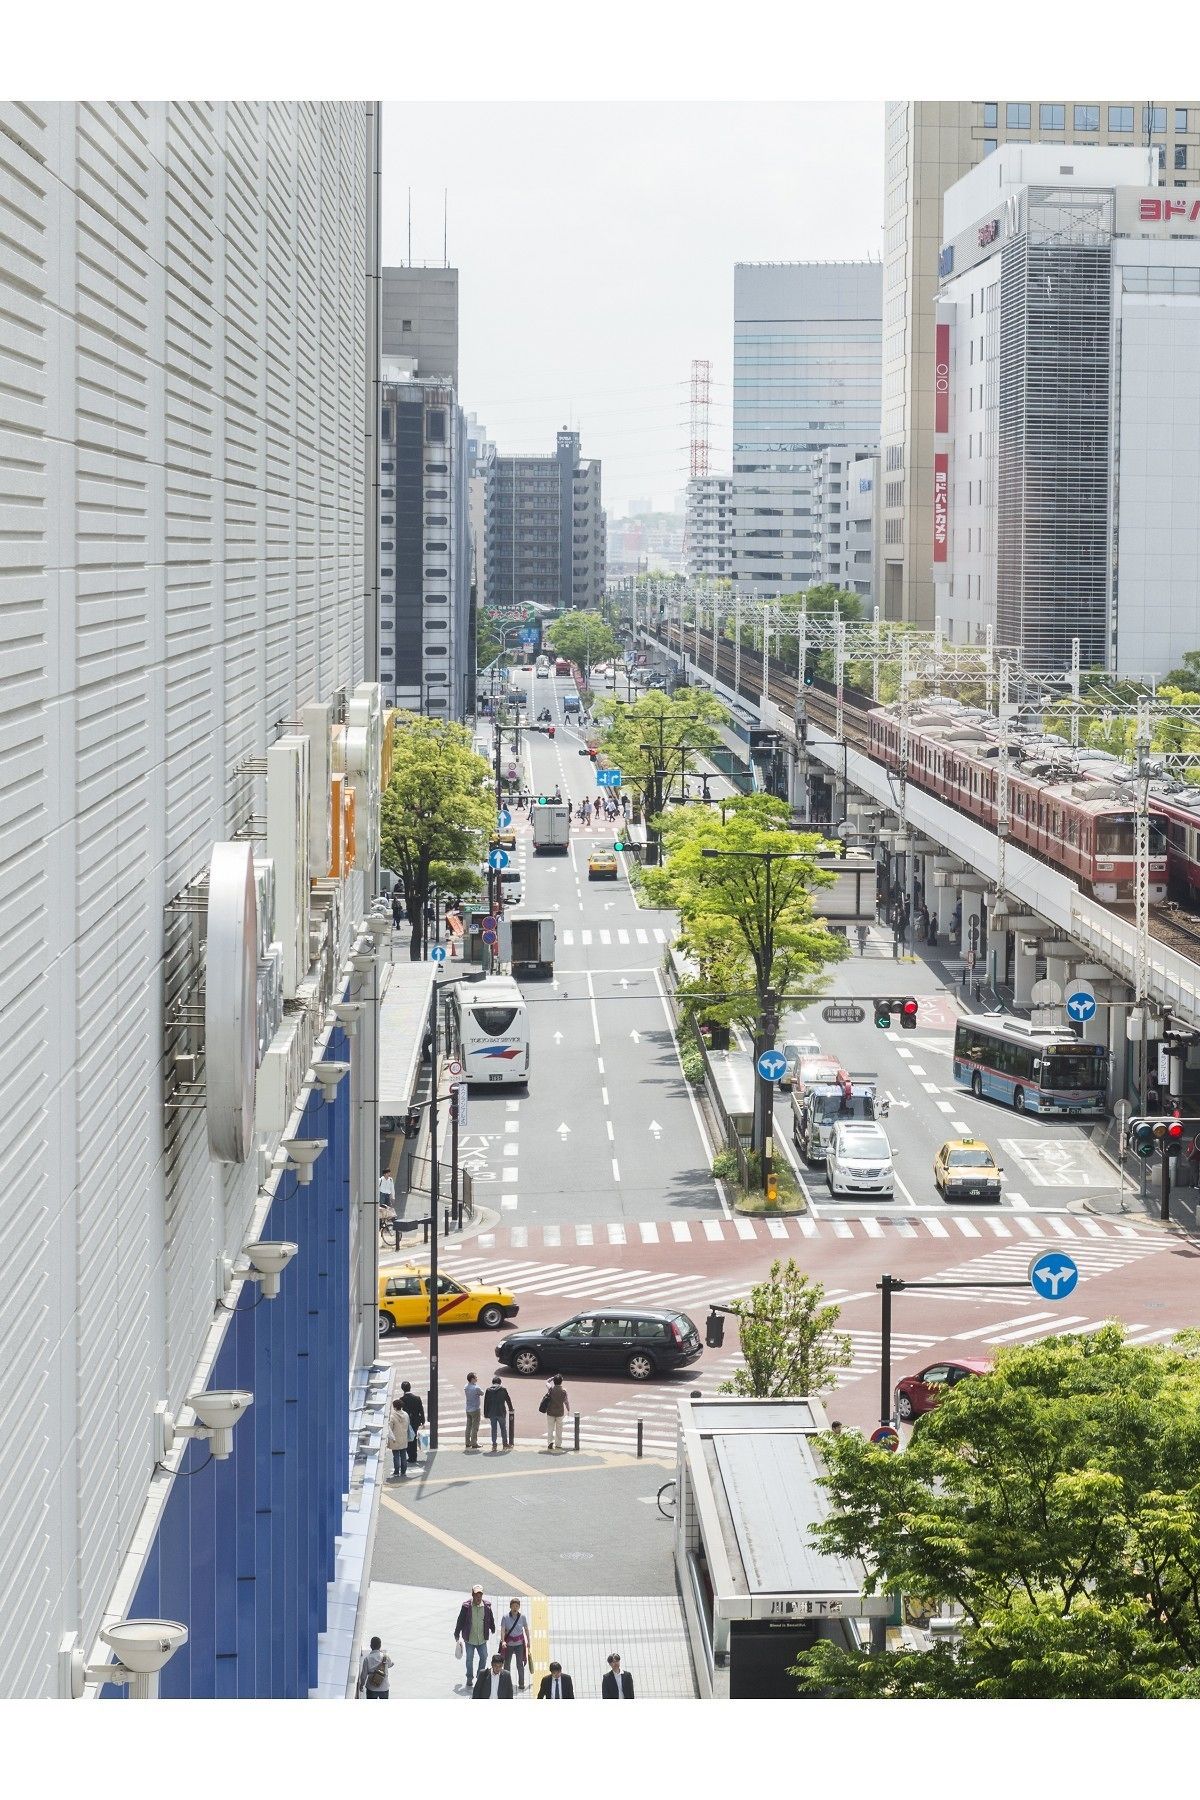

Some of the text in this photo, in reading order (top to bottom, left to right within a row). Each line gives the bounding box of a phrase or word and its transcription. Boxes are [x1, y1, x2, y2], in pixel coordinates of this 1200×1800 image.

[935, 471, 947, 544] ヨドバシカメラ
